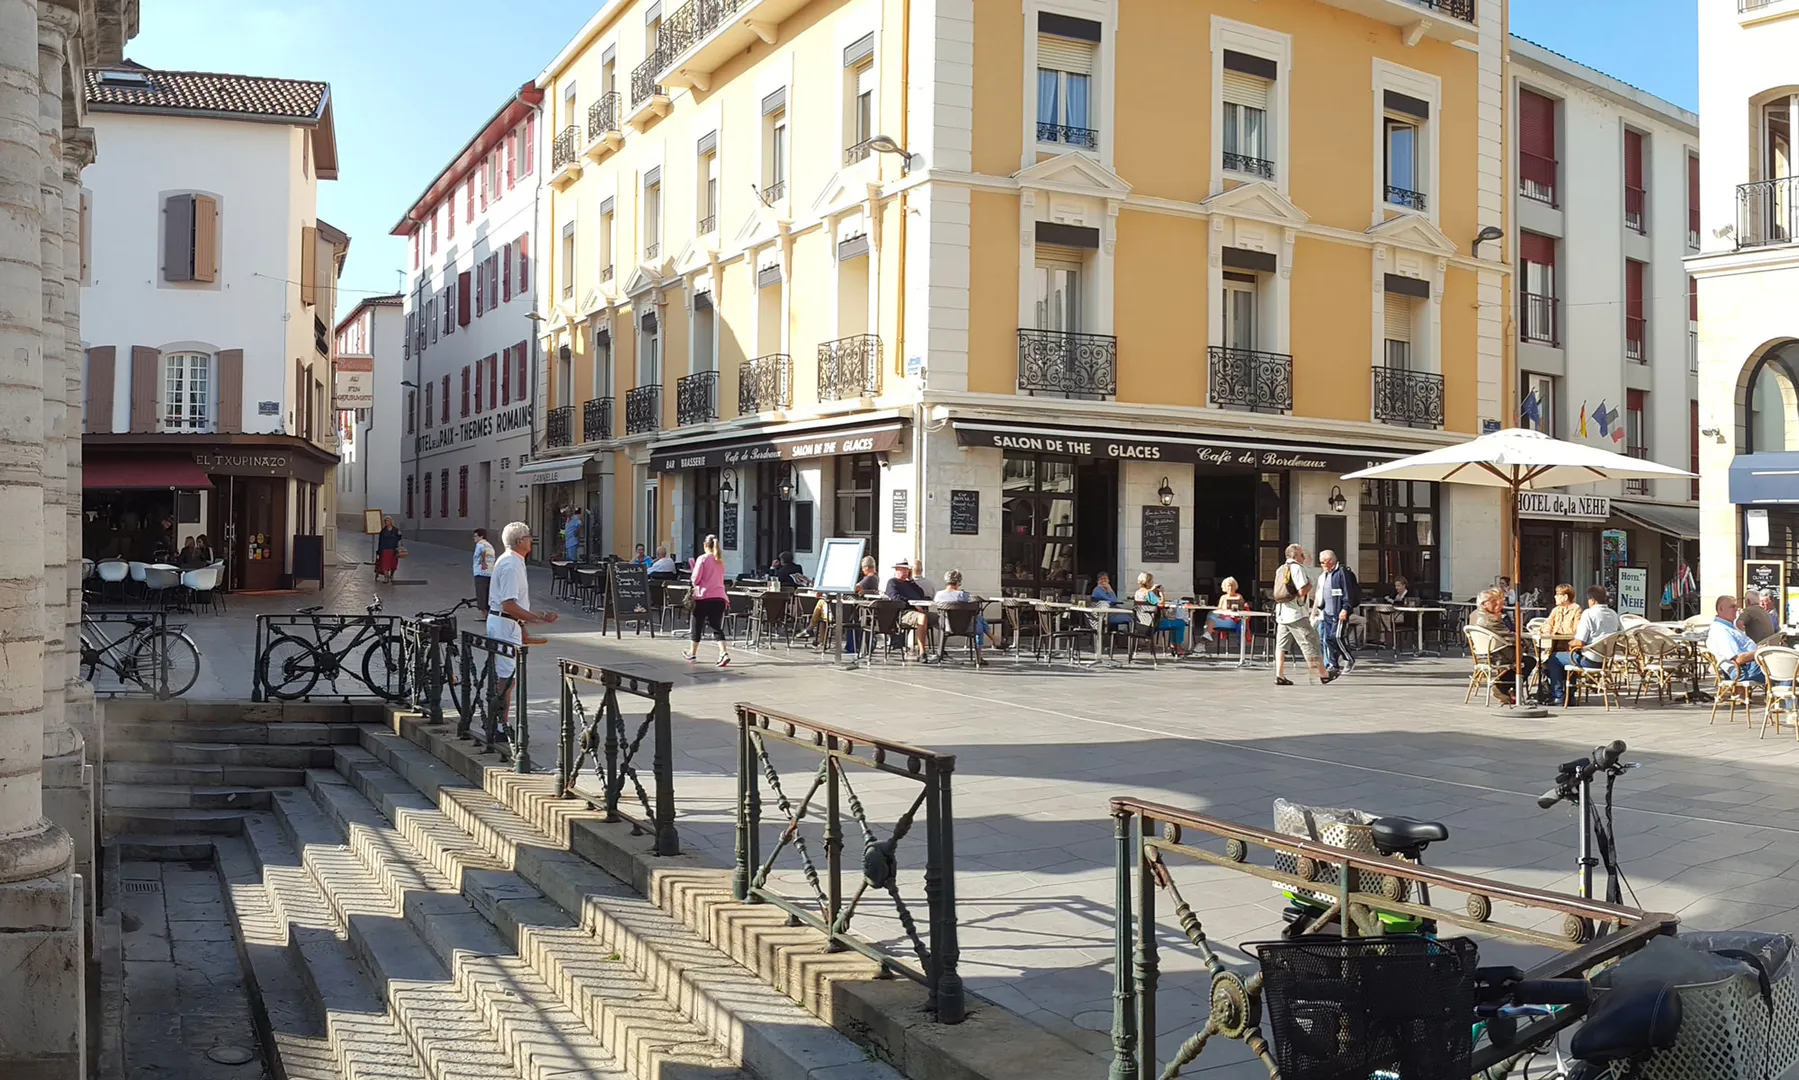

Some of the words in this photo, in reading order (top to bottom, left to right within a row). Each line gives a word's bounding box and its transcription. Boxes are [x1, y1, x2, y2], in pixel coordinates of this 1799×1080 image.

[440, 427, 454, 447] PAIX
[460, 416, 492, 442] THERMES
[497, 404, 532, 433] ROMAINS
[724, 452, 739, 465] Café
[741, 450, 748, 460] de
[750, 448, 782, 460] Bordeaux
[792, 443, 813, 457] SALON
[814, 443, 822, 454] DE
[824, 441, 836, 453] THE
[843, 438, 873, 452] GLACES
[993, 436, 1042, 450] SALON
[1046, 439, 1063, 451] DE
[1067, 441, 1091, 455] THE
[1108, 444, 1161, 459] GLACES
[196, 455, 210, 465] EL
[214, 456, 286, 467] TXUPINAZO
[665, 460, 675, 469] BAR
[681, 456, 705, 468] BRASSERIE
[1197, 447, 1232, 465] Café
[1238, 451, 1254, 464] de
[1262, 452, 1327, 468] Bordeaux
[1553, 496, 1563, 512] de
[1568, 497, 1576, 513] la
[1579, 497, 1606, 515] NEHE
